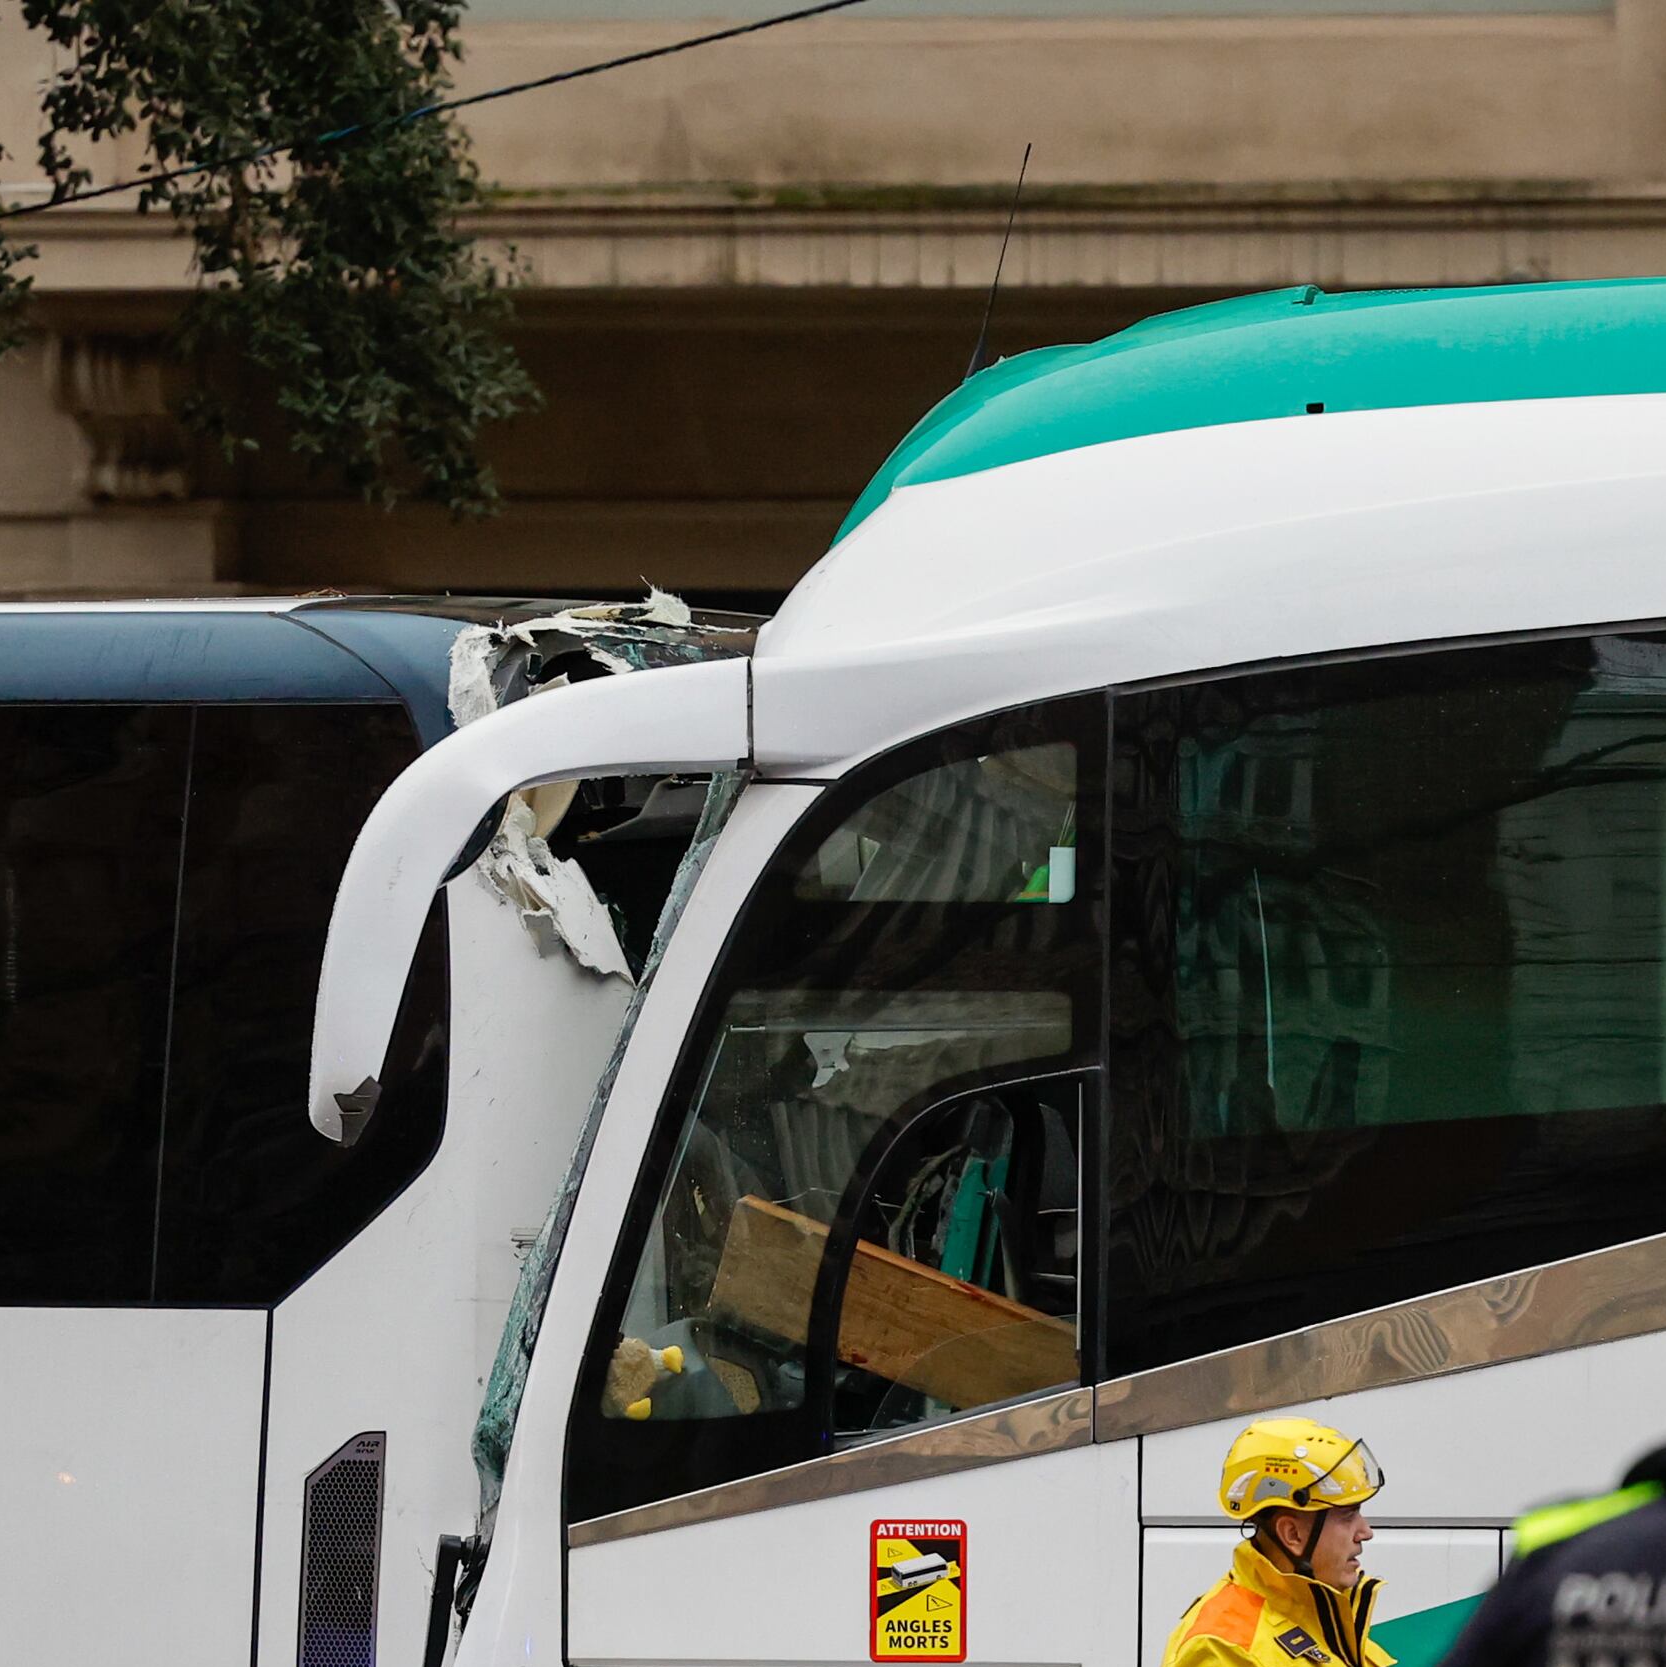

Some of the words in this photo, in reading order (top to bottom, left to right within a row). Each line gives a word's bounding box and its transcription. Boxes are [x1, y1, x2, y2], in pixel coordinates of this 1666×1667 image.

[876, 1523, 962, 1536] ATTENTION
[885, 1619, 953, 1633] ANGLES
[888, 1635, 950, 1649] MORTS
